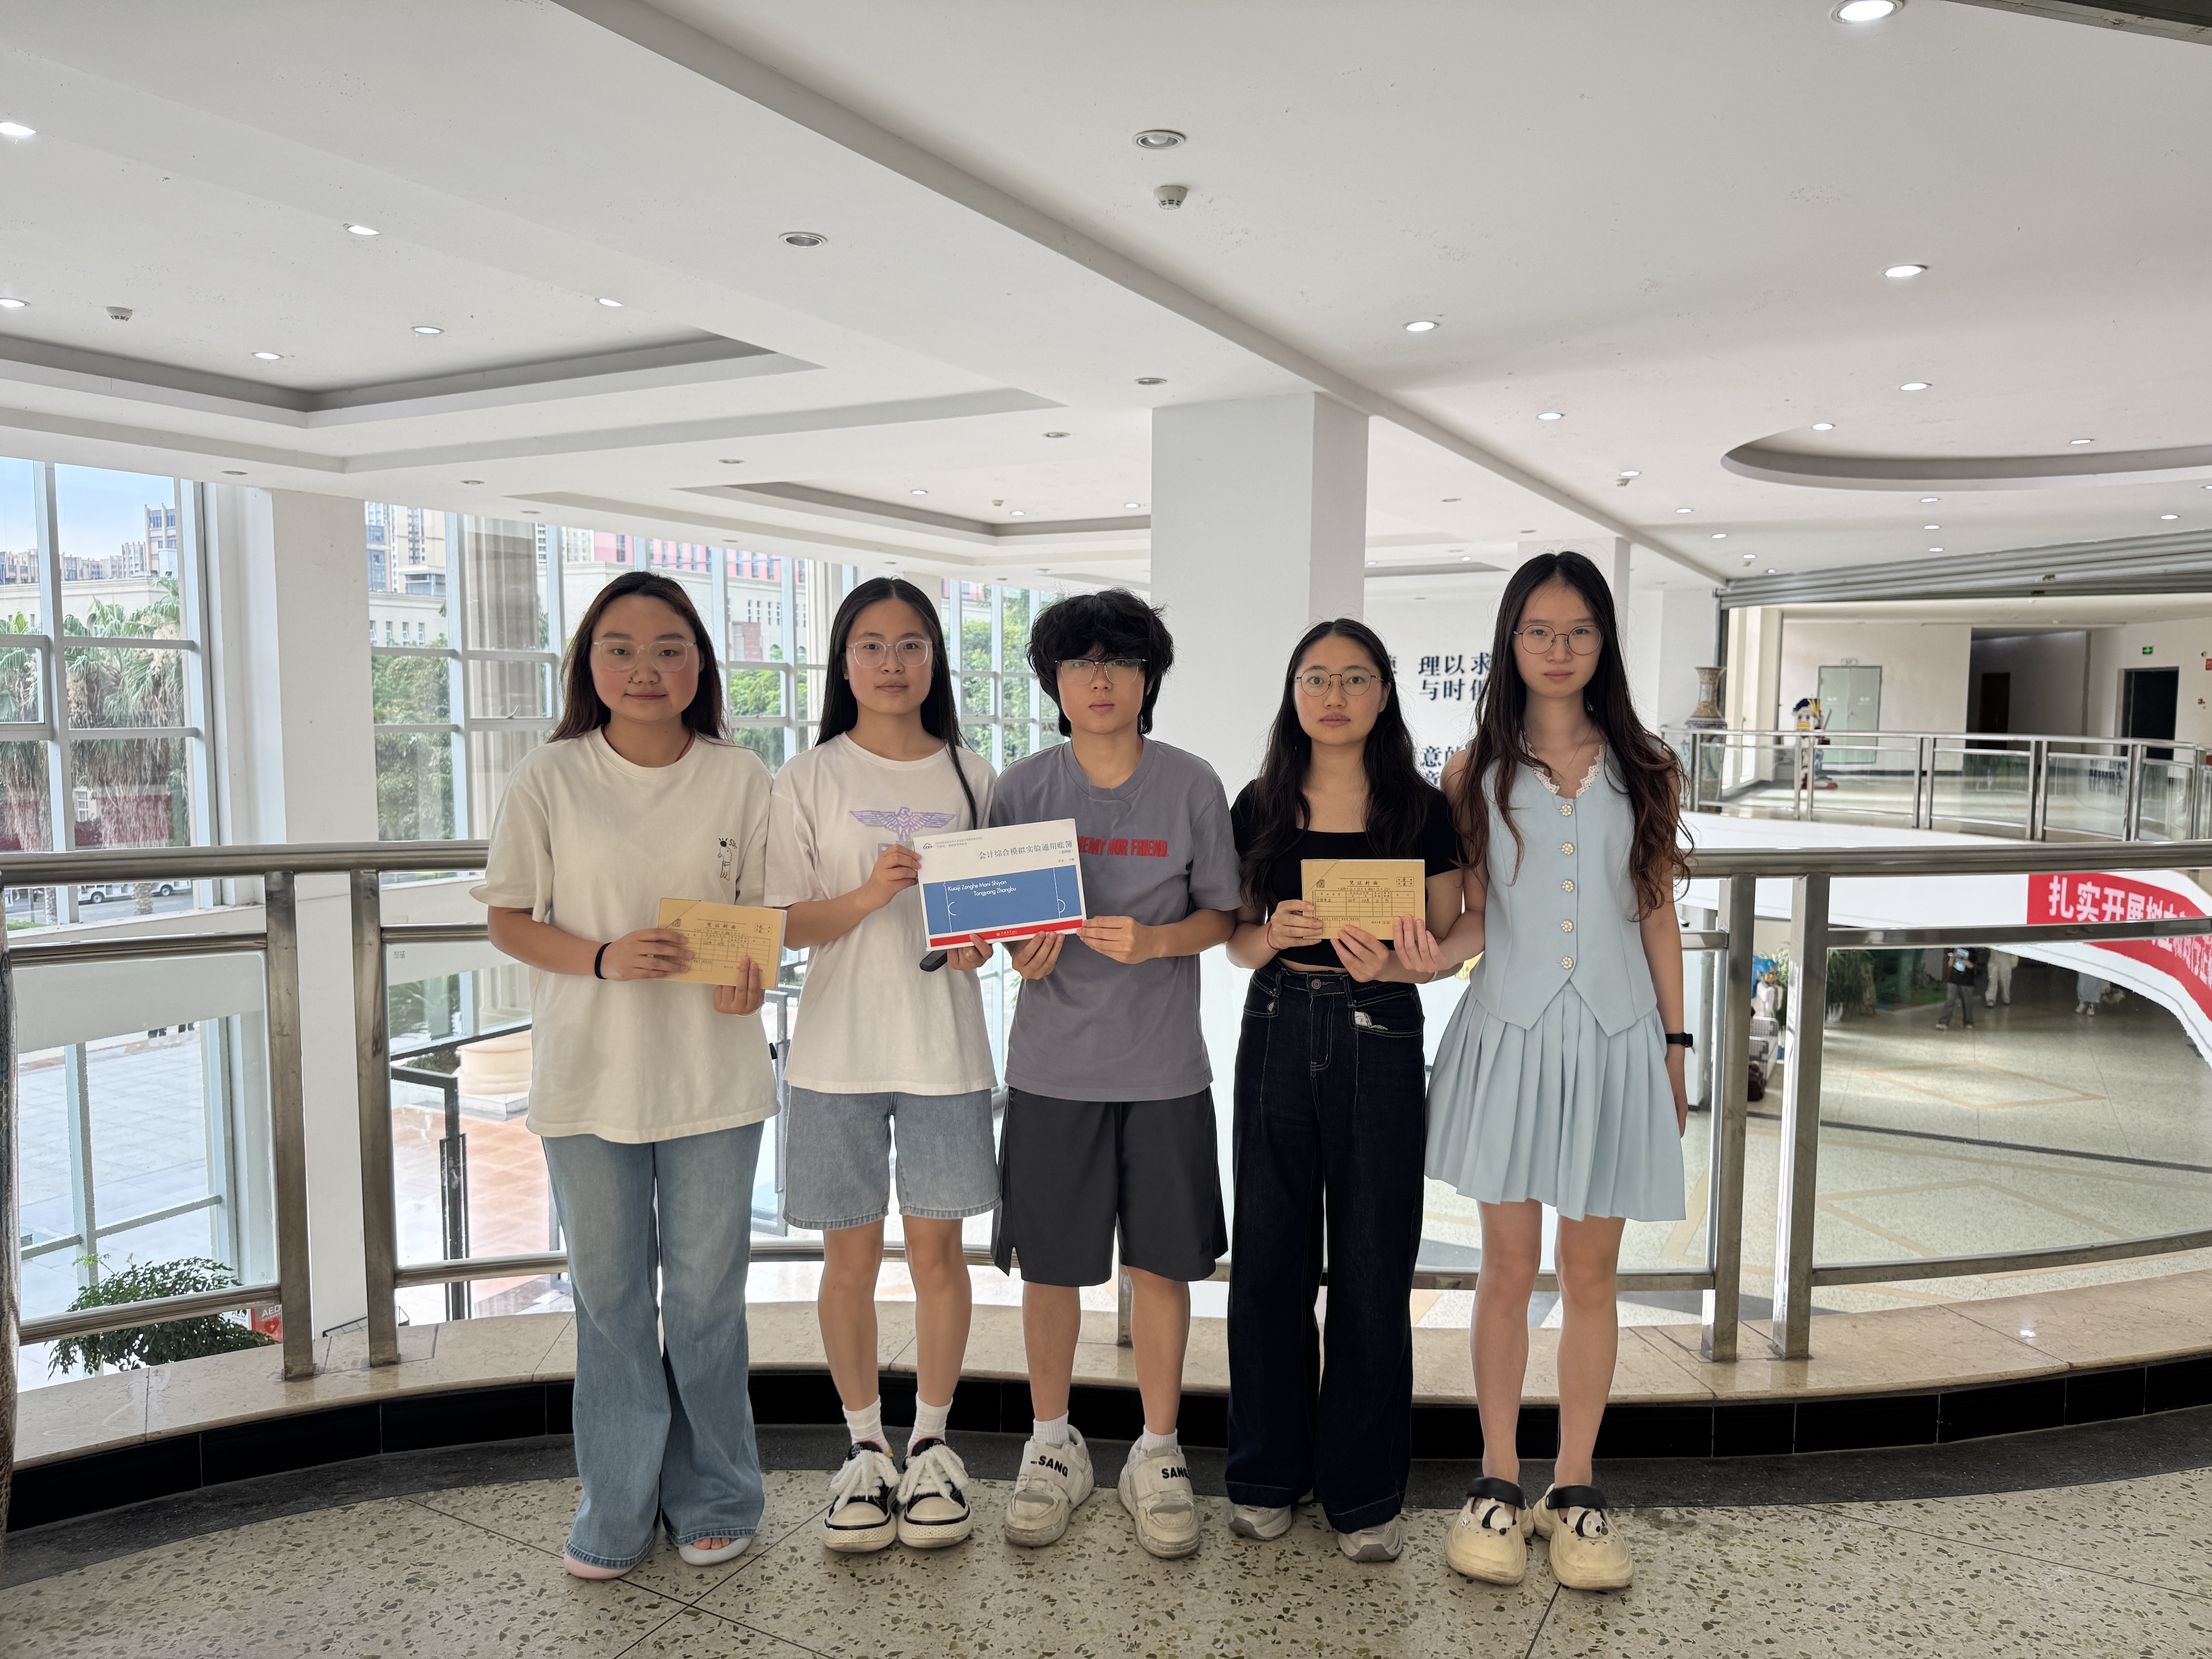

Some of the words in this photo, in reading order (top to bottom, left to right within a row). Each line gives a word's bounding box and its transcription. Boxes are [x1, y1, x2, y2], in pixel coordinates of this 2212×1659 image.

[979, 840, 1072, 859] 会计综合模拟实验通用账簿
[262, 1305, 281, 1317] AED
